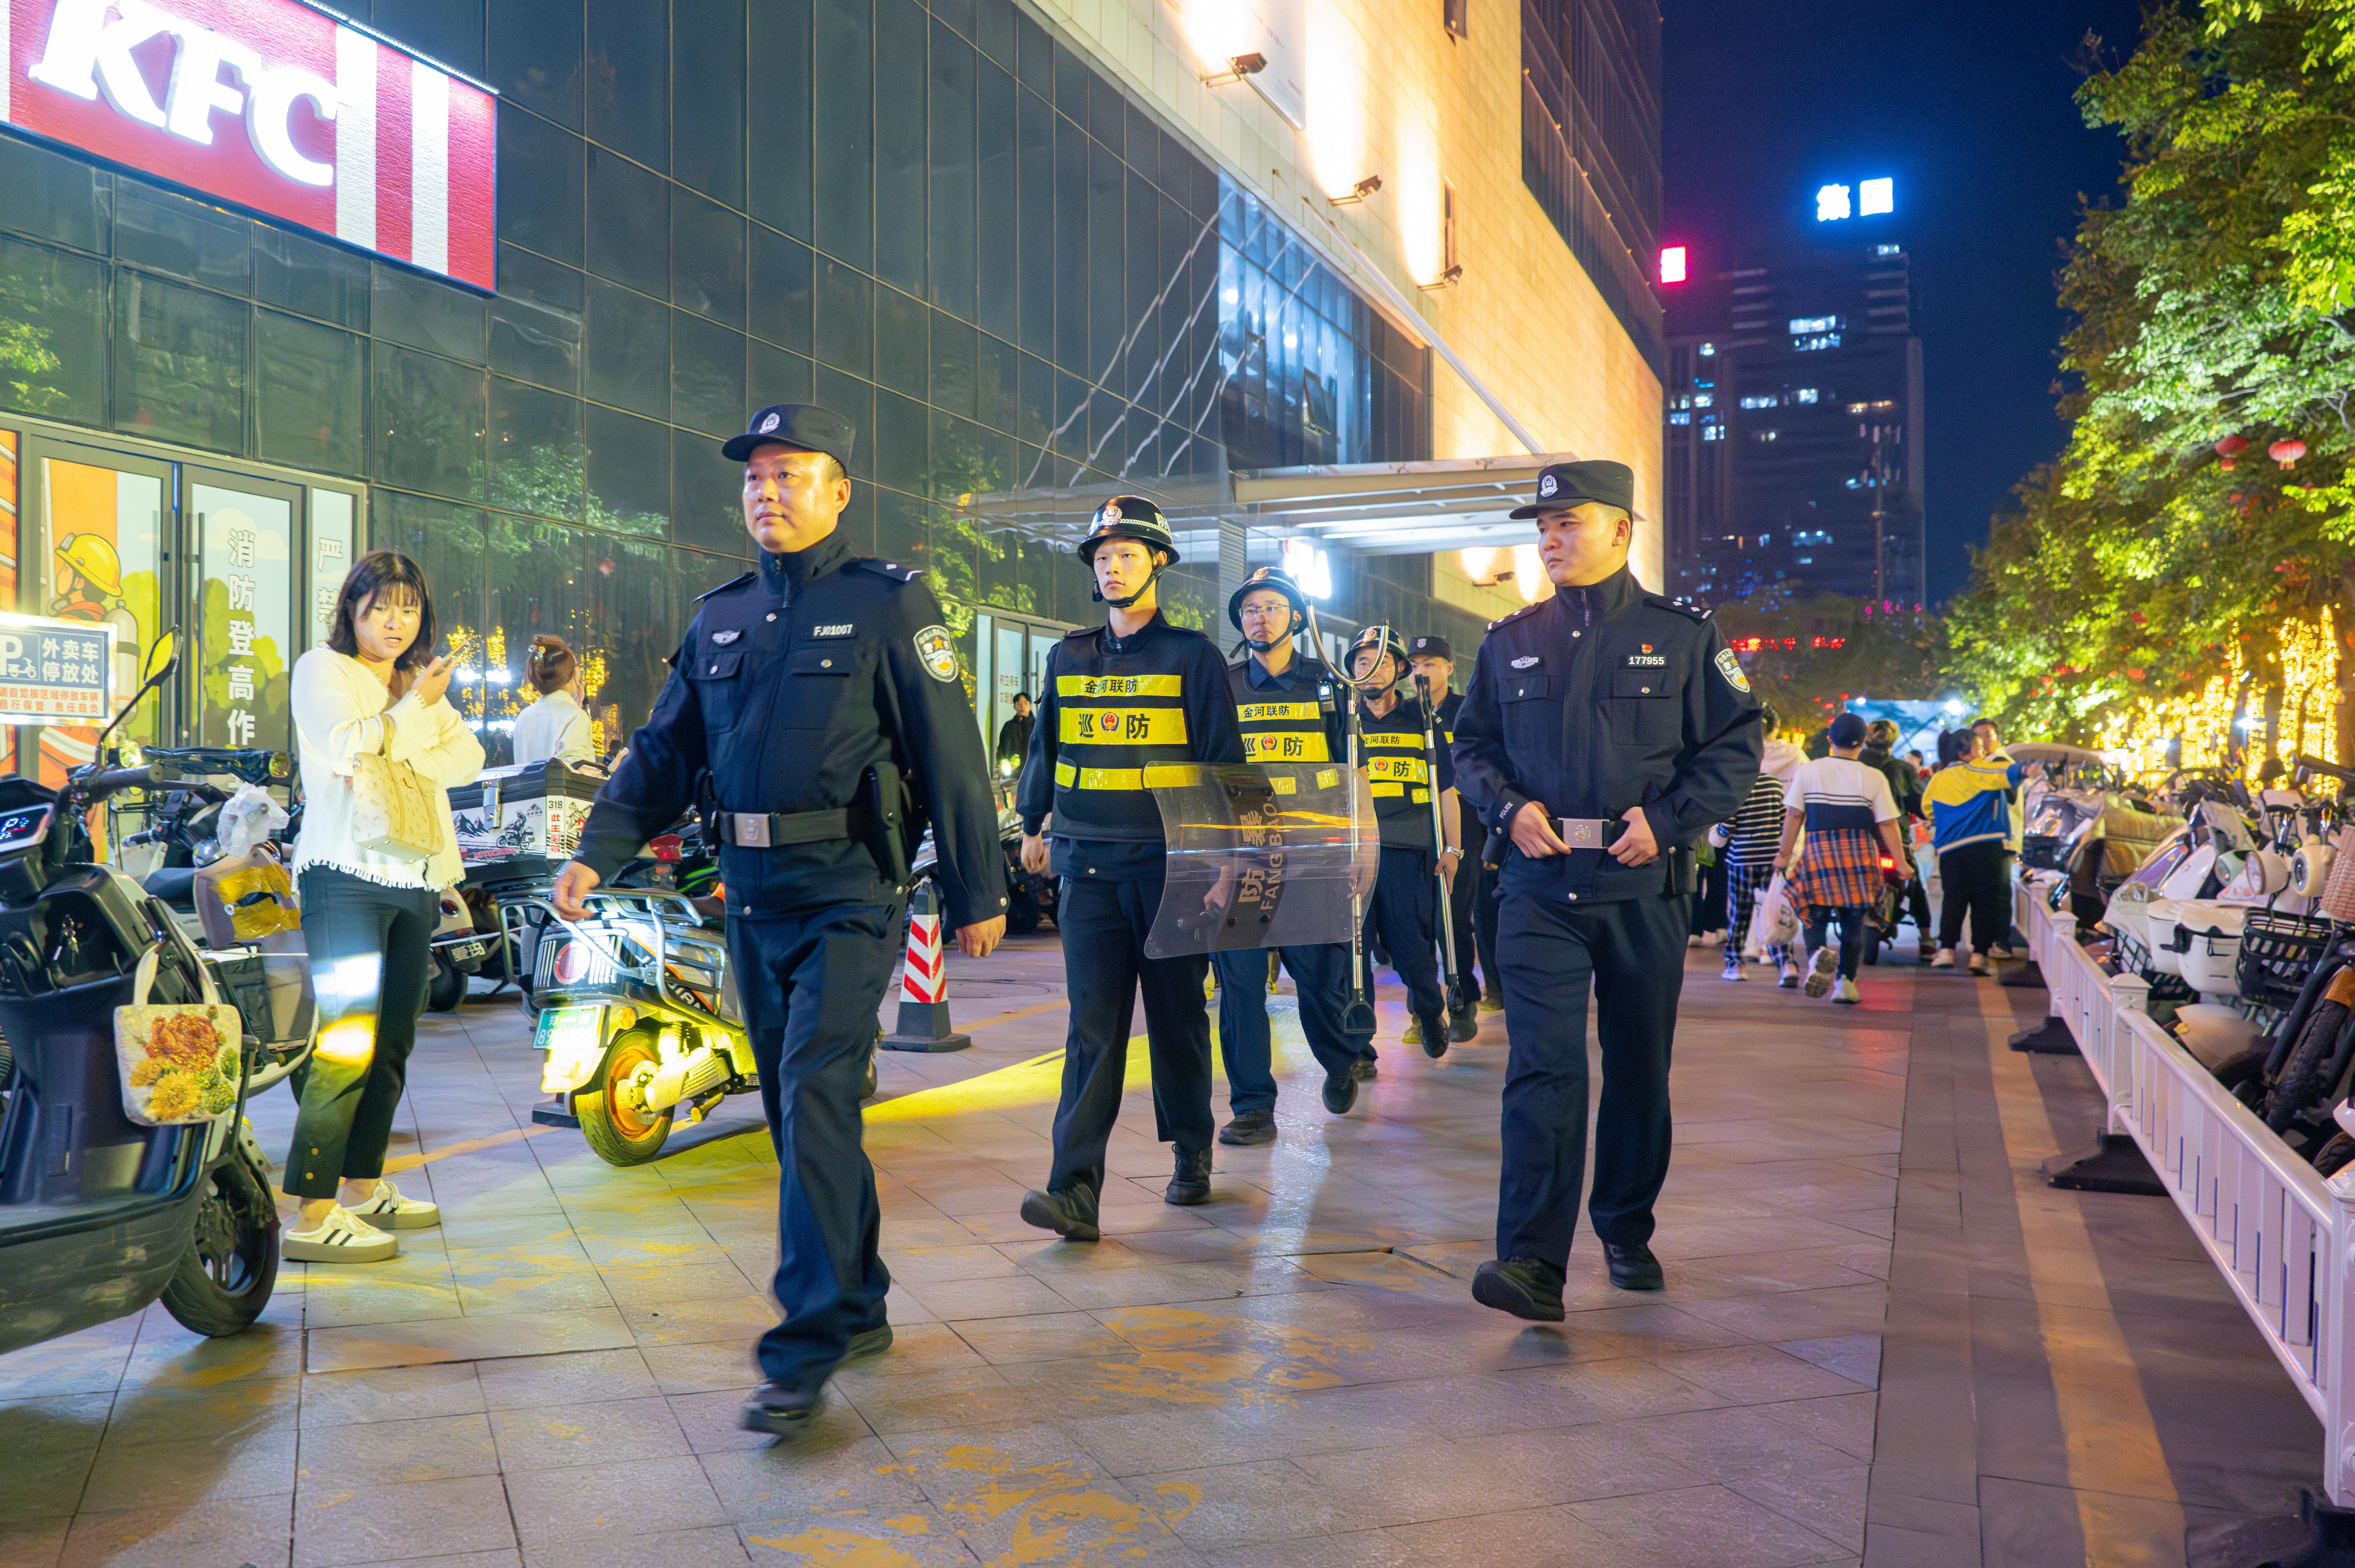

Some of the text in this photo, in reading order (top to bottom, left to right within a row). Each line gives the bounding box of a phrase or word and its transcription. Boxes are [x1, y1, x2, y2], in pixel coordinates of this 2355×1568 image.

[27, 0, 337, 186] KFC
[317, 537, 343, 647] 严禁
[813, 624, 852, 636] FJ01007
[0, 634, 23, 676] P
[42, 637, 99, 662] 外卖车
[227, 529, 255, 788] 消防登高作
[1629, 656, 1664, 665] 177955
[42, 661, 99, 684] 停放处
[1084, 679, 1138, 694] 金河联防
[0, 699, 98, 714] 自行保管 责任自负
[1244, 705, 1290, 718] 金河联防
[1078, 713, 1151, 739] 巡 防
[1284, 737, 1304, 756] 防
[1394, 761, 1411, 777] 防
[551, 814, 561, 852] 此生必驾
[1238, 810, 1266, 902] 防暴
[1260, 803, 1283, 910] FANGBAO
